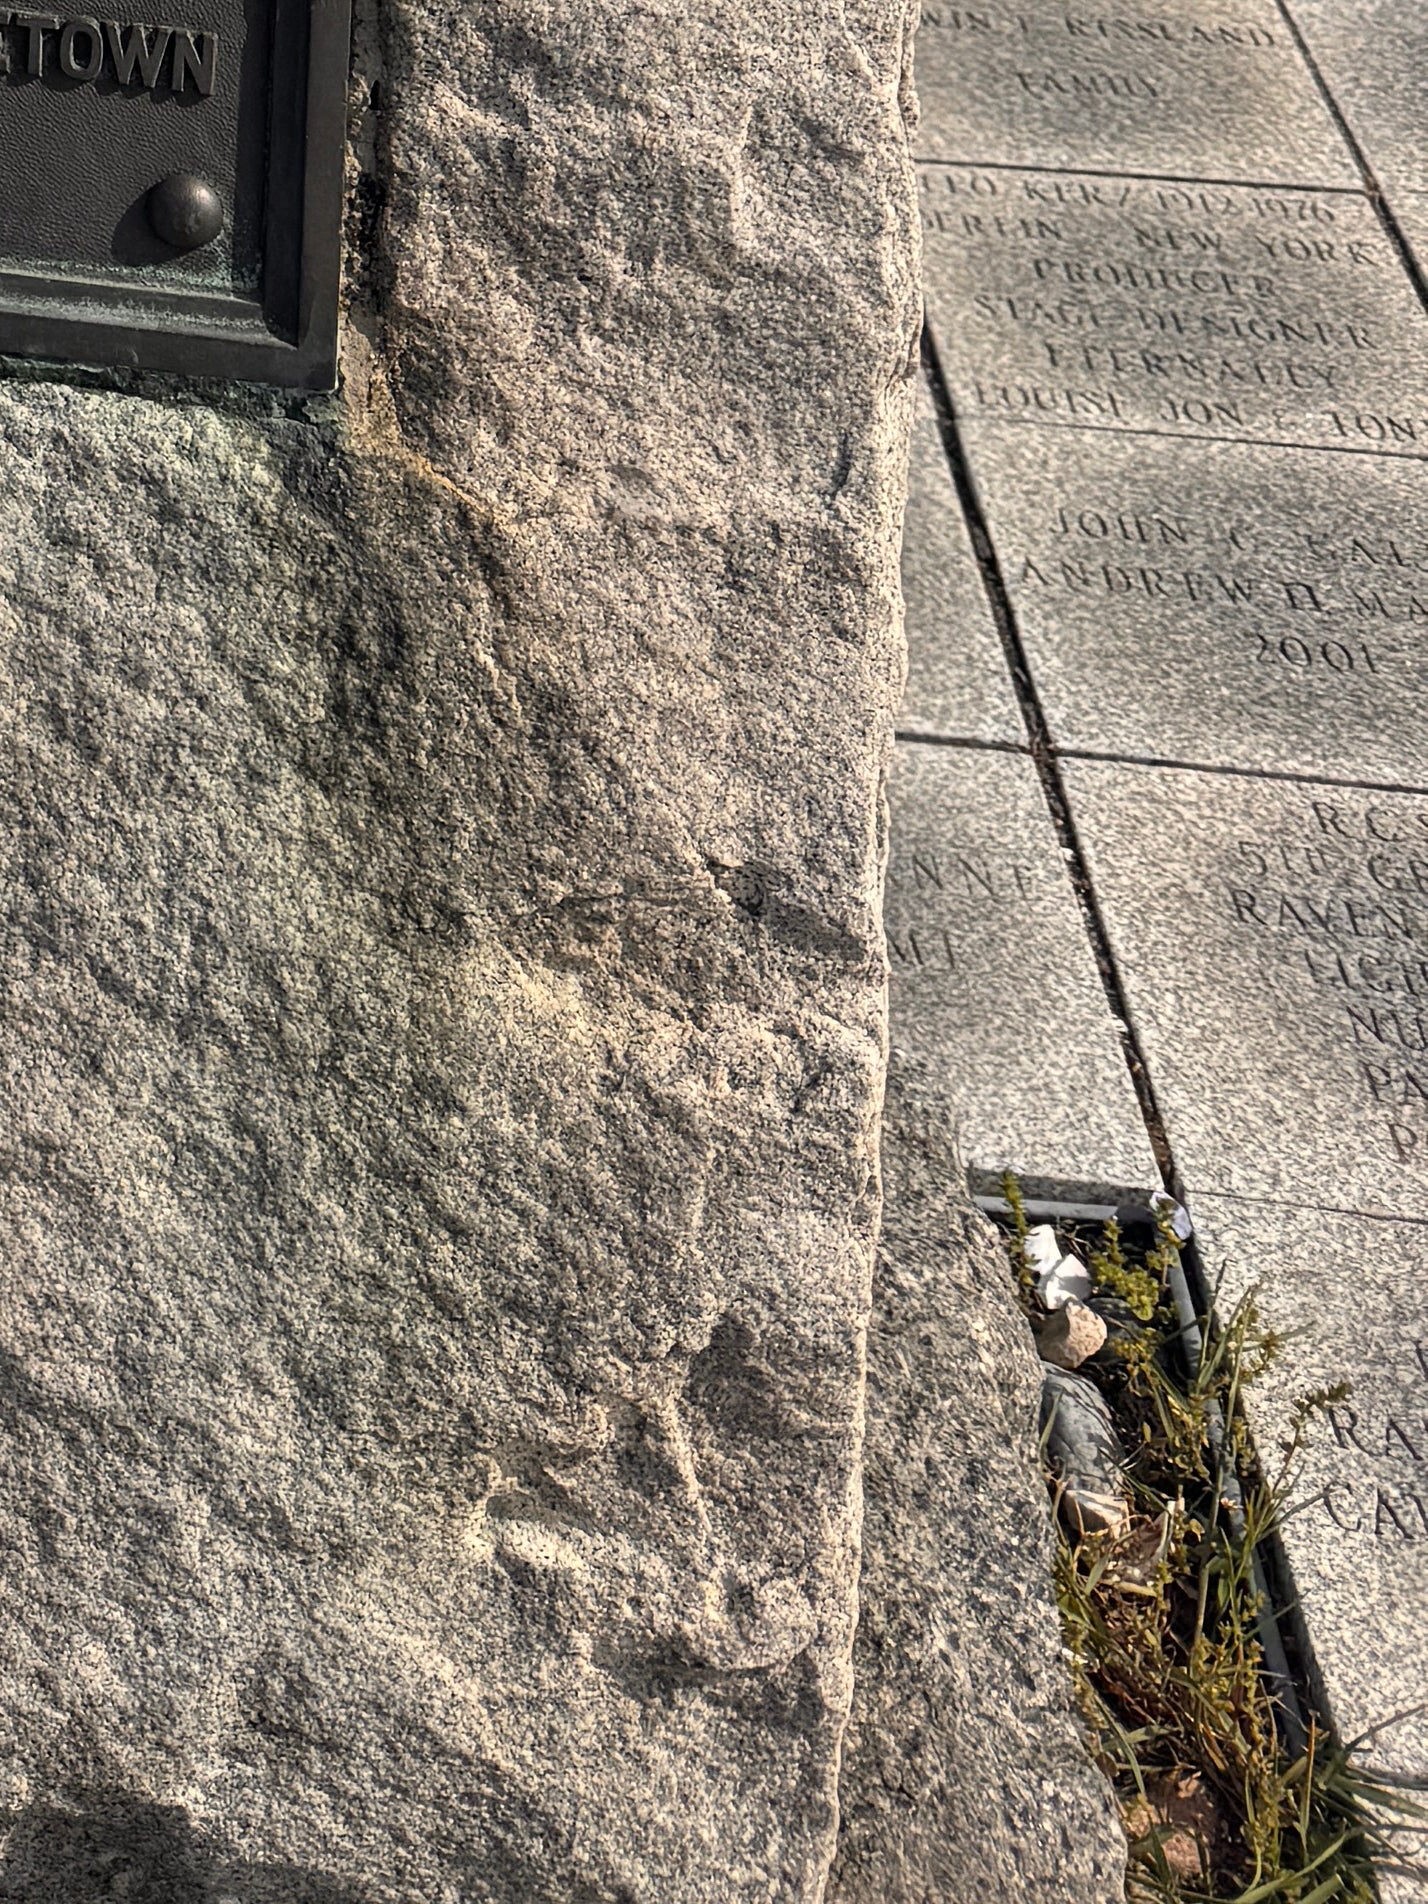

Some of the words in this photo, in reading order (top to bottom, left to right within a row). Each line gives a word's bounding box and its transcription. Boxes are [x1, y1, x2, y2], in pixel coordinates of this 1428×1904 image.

[1048, 506, 1190, 547] JOHN
[1019, 554, 1254, 607] ANDREW
[1255, 631, 1381, 676] 2001
